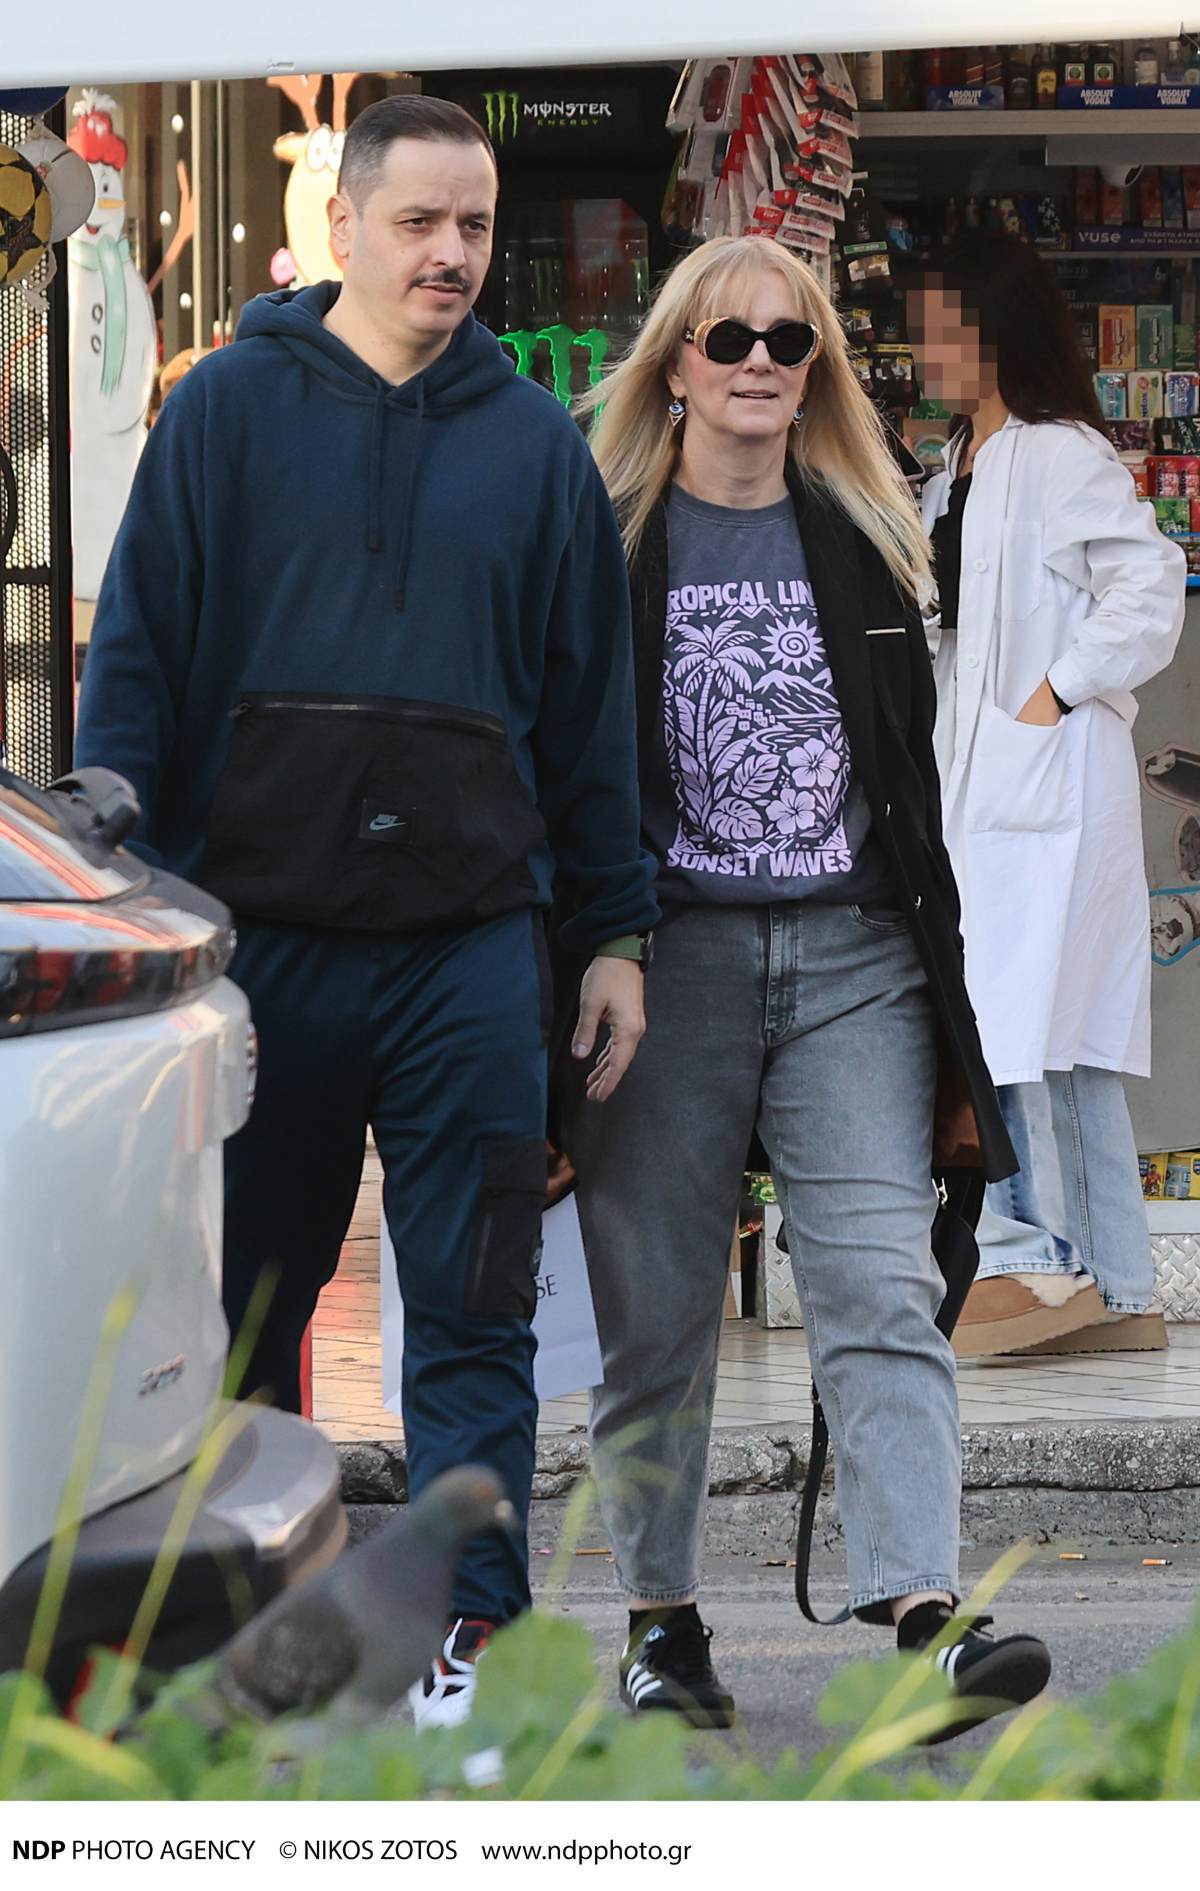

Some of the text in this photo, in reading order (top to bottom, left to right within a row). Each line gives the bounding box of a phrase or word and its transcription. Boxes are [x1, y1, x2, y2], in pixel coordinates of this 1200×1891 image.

[948, 89, 982, 98] ABSOLUT
[1080, 89, 1114, 98] ABSOLUT
[1156, 89, 1191, 98] ABSOLUT
[952, 96, 979, 105] VODKA
[1084, 96, 1111, 105] VODKA
[1161, 96, 1188, 105] VODKA
[523, 100, 612, 118] MONSTER
[666, 849, 852, 877] SUNSET WAVES
